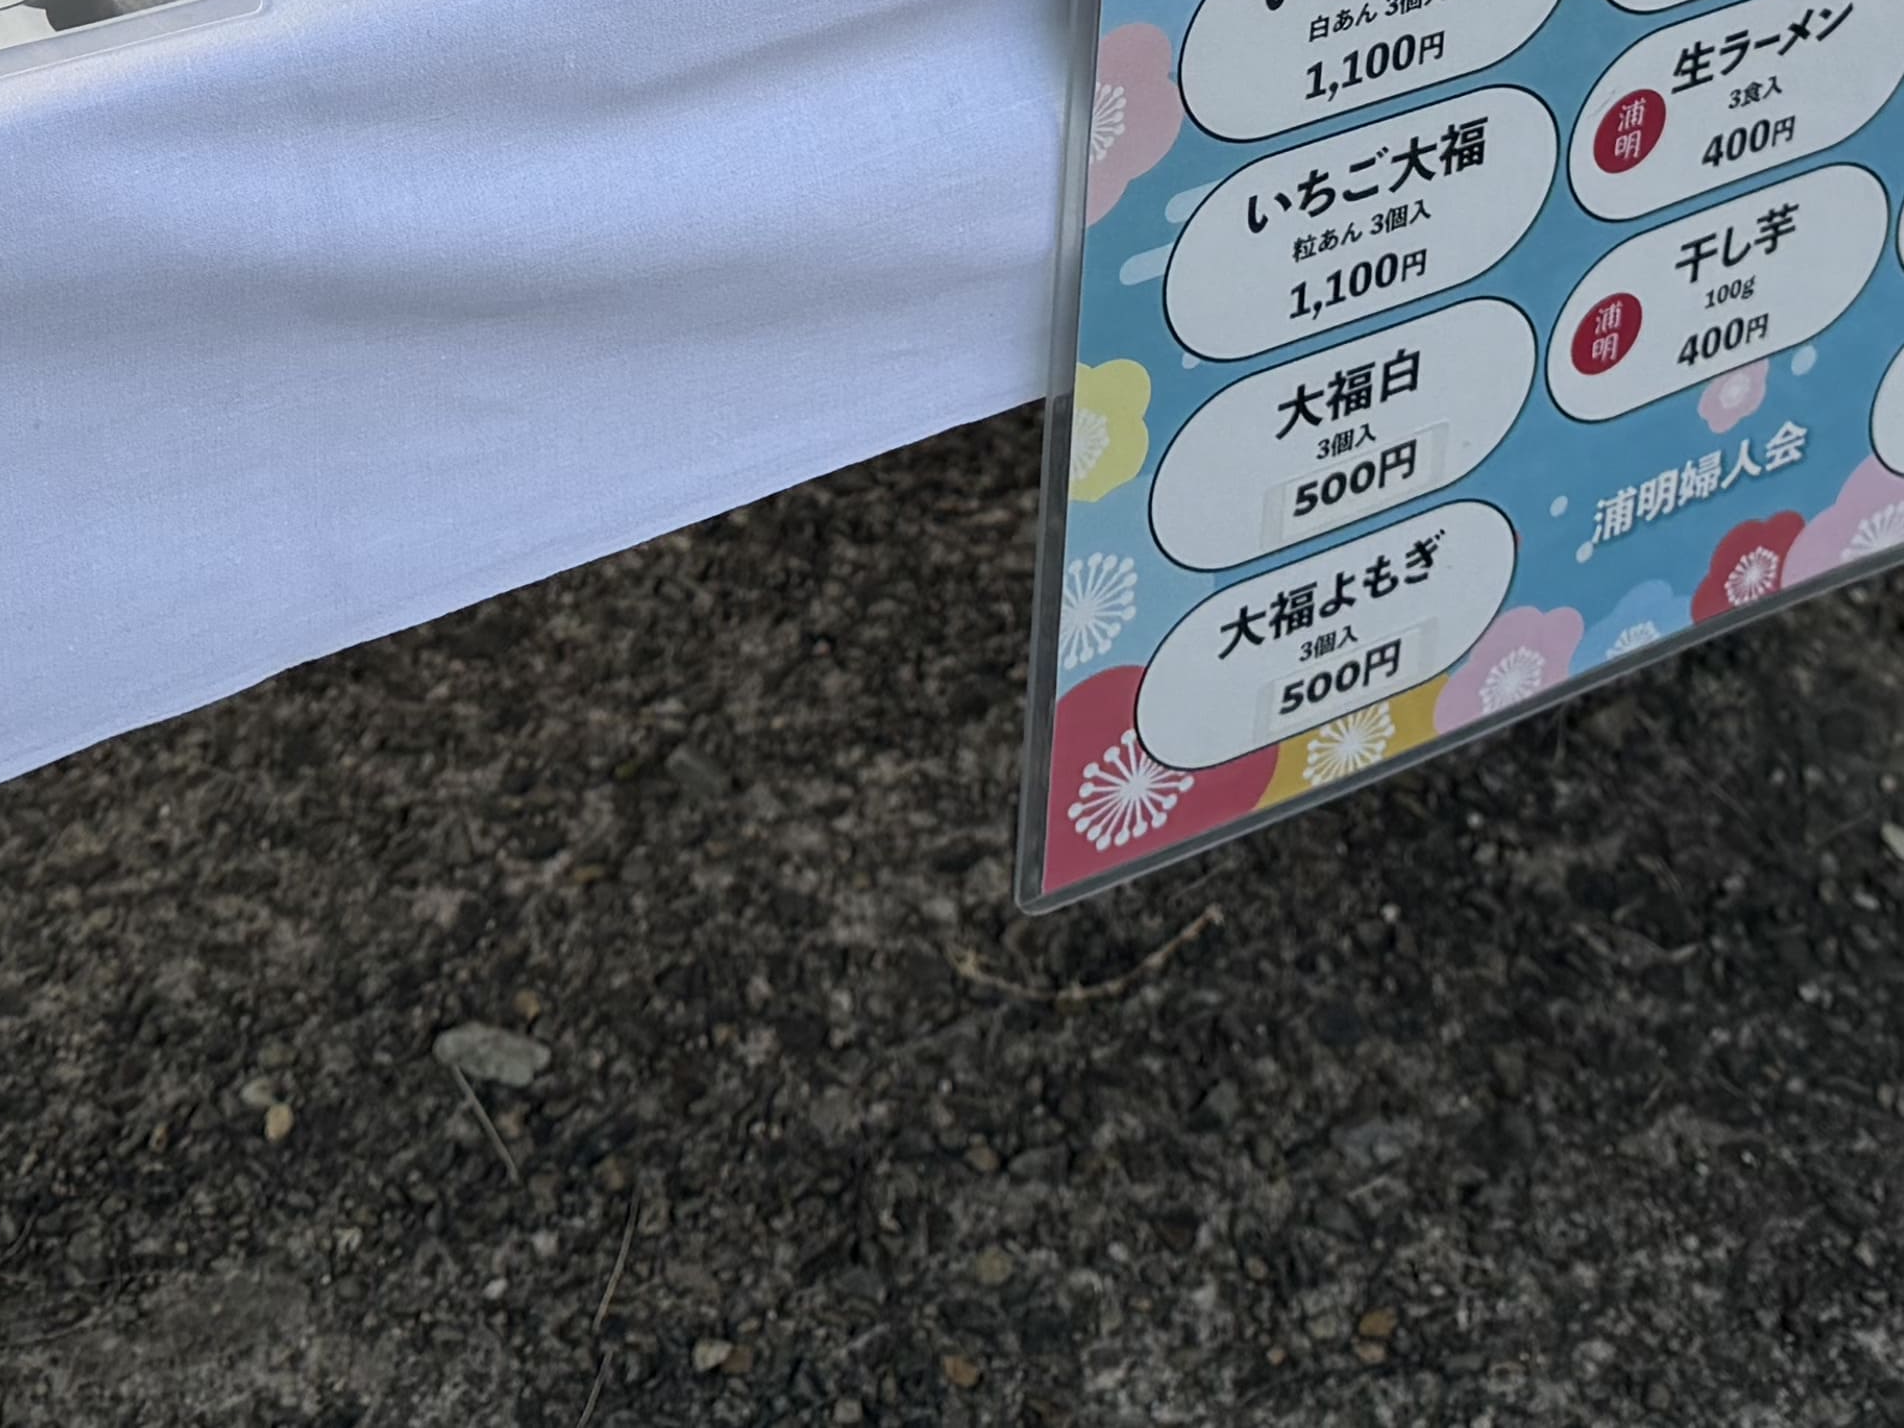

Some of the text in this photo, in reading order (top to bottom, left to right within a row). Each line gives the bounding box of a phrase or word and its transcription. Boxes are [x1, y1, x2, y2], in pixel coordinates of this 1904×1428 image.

[1308, 2, 1378, 43] 白あん
[1671, 2, 1854, 95] 生ラーメン
[1305, 30, 1445, 102] 1,100円
[1728, 75, 1783, 110] 3食入
[1612, 96, 1648, 162] 浦明
[1701, 115, 1796, 167] 400円
[1247, 116, 1489, 234] いちご大福
[1292, 199, 1432, 263] 粒あん 3個入
[1675, 203, 1800, 284] 干し芋
[1289, 248, 1427, 321] 1,100円
[1704, 275, 1756, 310] 100g
[1677, 313, 1769, 366] 400円
[1275, 348, 1421, 441] 大福白
[1316, 422, 1377, 460] 3個入
[1293, 438, 1417, 517] 500円
[1591, 421, 1807, 543] 浦明婦人会
[1218, 528, 1446, 660] 大福よもぎ
[1279, 638, 1402, 715] 500円
[1299, 624, 1359, 662] 3個入
